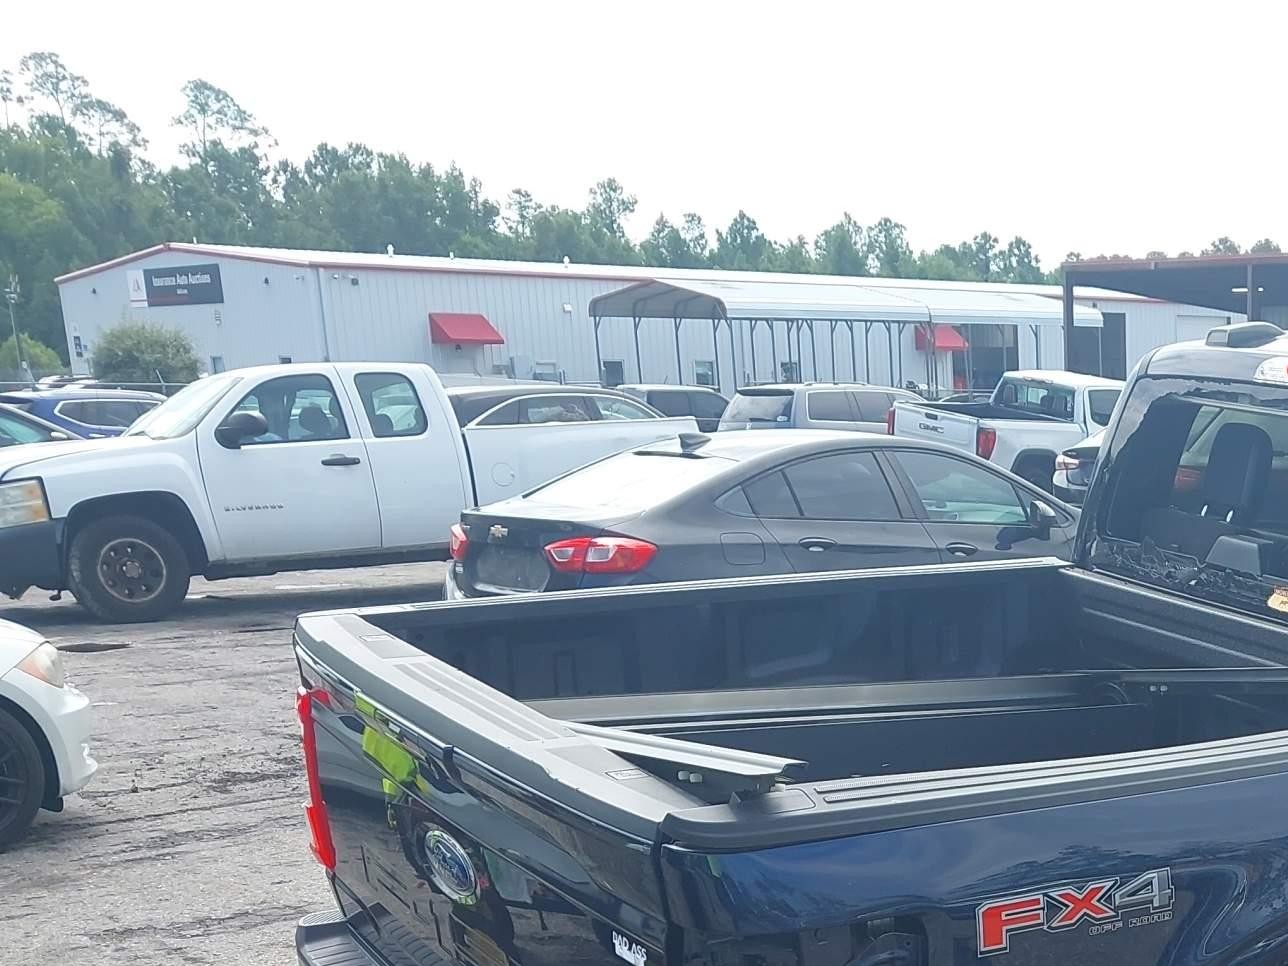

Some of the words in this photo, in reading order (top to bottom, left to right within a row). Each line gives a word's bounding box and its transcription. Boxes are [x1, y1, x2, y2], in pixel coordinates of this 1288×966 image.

[918, 422, 945, 434] GMC
[975, 866, 1175, 958] FX4
[1089, 921, 1124, 936] OFF
[1128, 910, 1174, 929] ROAD
[631, 942, 647, 961] ASS
